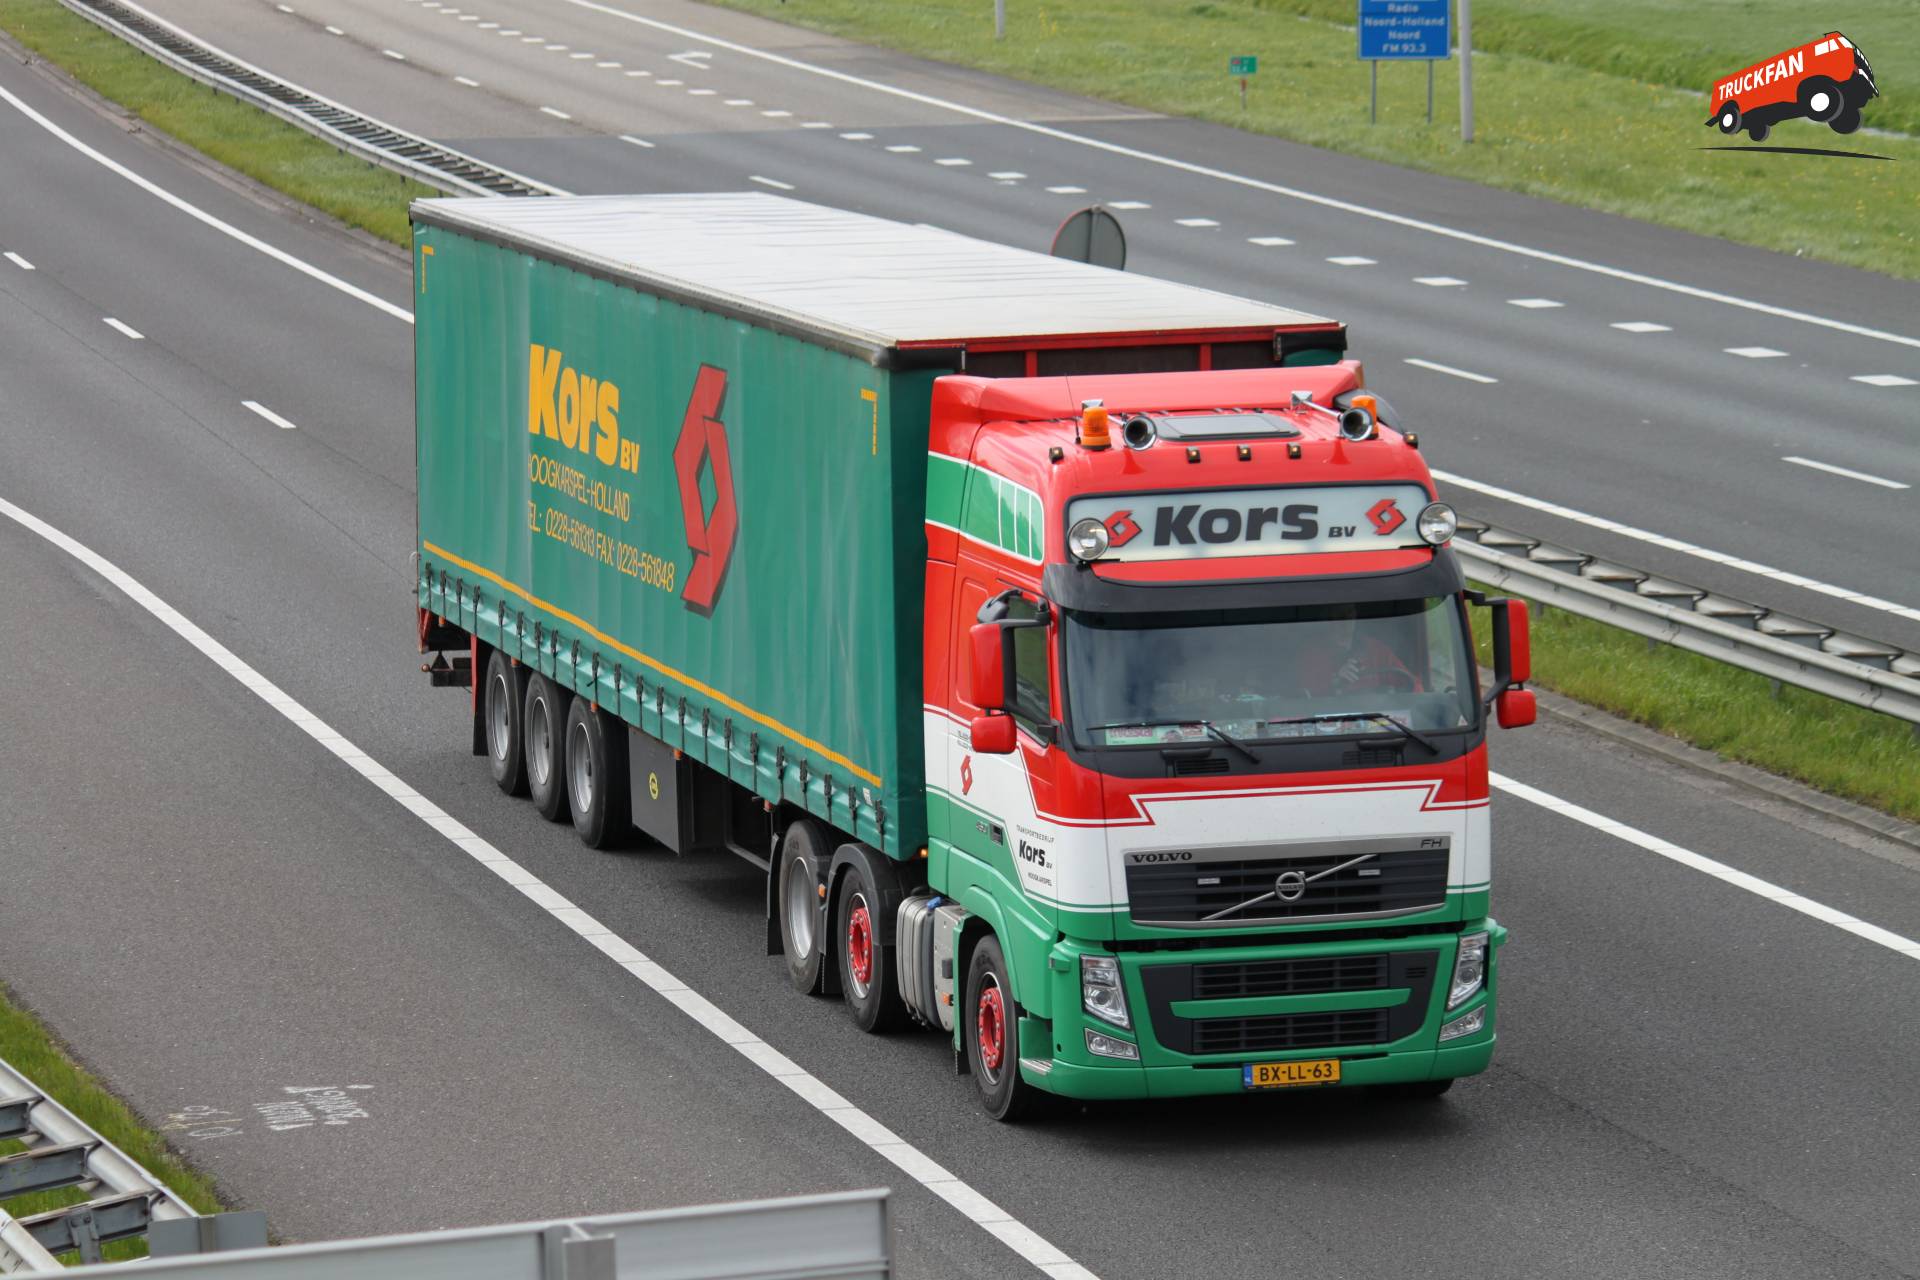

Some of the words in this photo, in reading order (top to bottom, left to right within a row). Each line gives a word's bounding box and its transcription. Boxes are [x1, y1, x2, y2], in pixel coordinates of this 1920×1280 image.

[1387, 3, 1419, 13] Radio
[1364, 17, 1445, 26] Noord-Holland
[1388, 30, 1421, 40] Noord
[1382, 43, 1399, 53] FM
[528, 343, 619, 466] Kors
[620, 438, 640, 474] BV
[1153, 504, 1319, 547] Kors
[1328, 525, 1356, 539] BV
[616, 541, 675, 593] 0228-561848
[1420, 837, 1443, 849] FH
[1019, 839, 1046, 867] Kors
[1131, 851, 1193, 864] VOLVO
[1260, 1062, 1333, 1082] BX-LL-63
